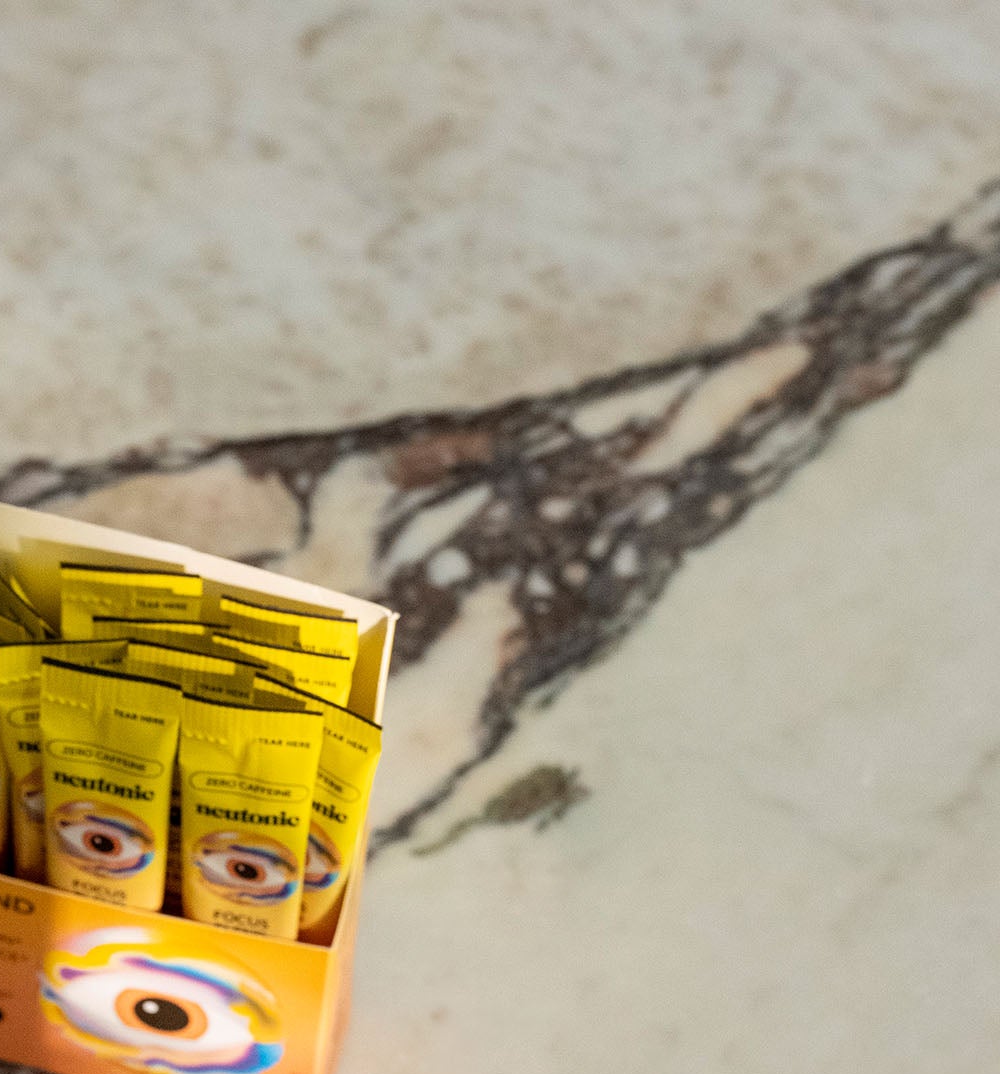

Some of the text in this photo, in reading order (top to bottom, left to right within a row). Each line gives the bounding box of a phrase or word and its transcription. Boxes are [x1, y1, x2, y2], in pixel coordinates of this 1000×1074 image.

[54, 770, 155, 802] neutonic
[196, 803, 300, 828] neutonic
[212, 911, 269, 930] FOCUS
